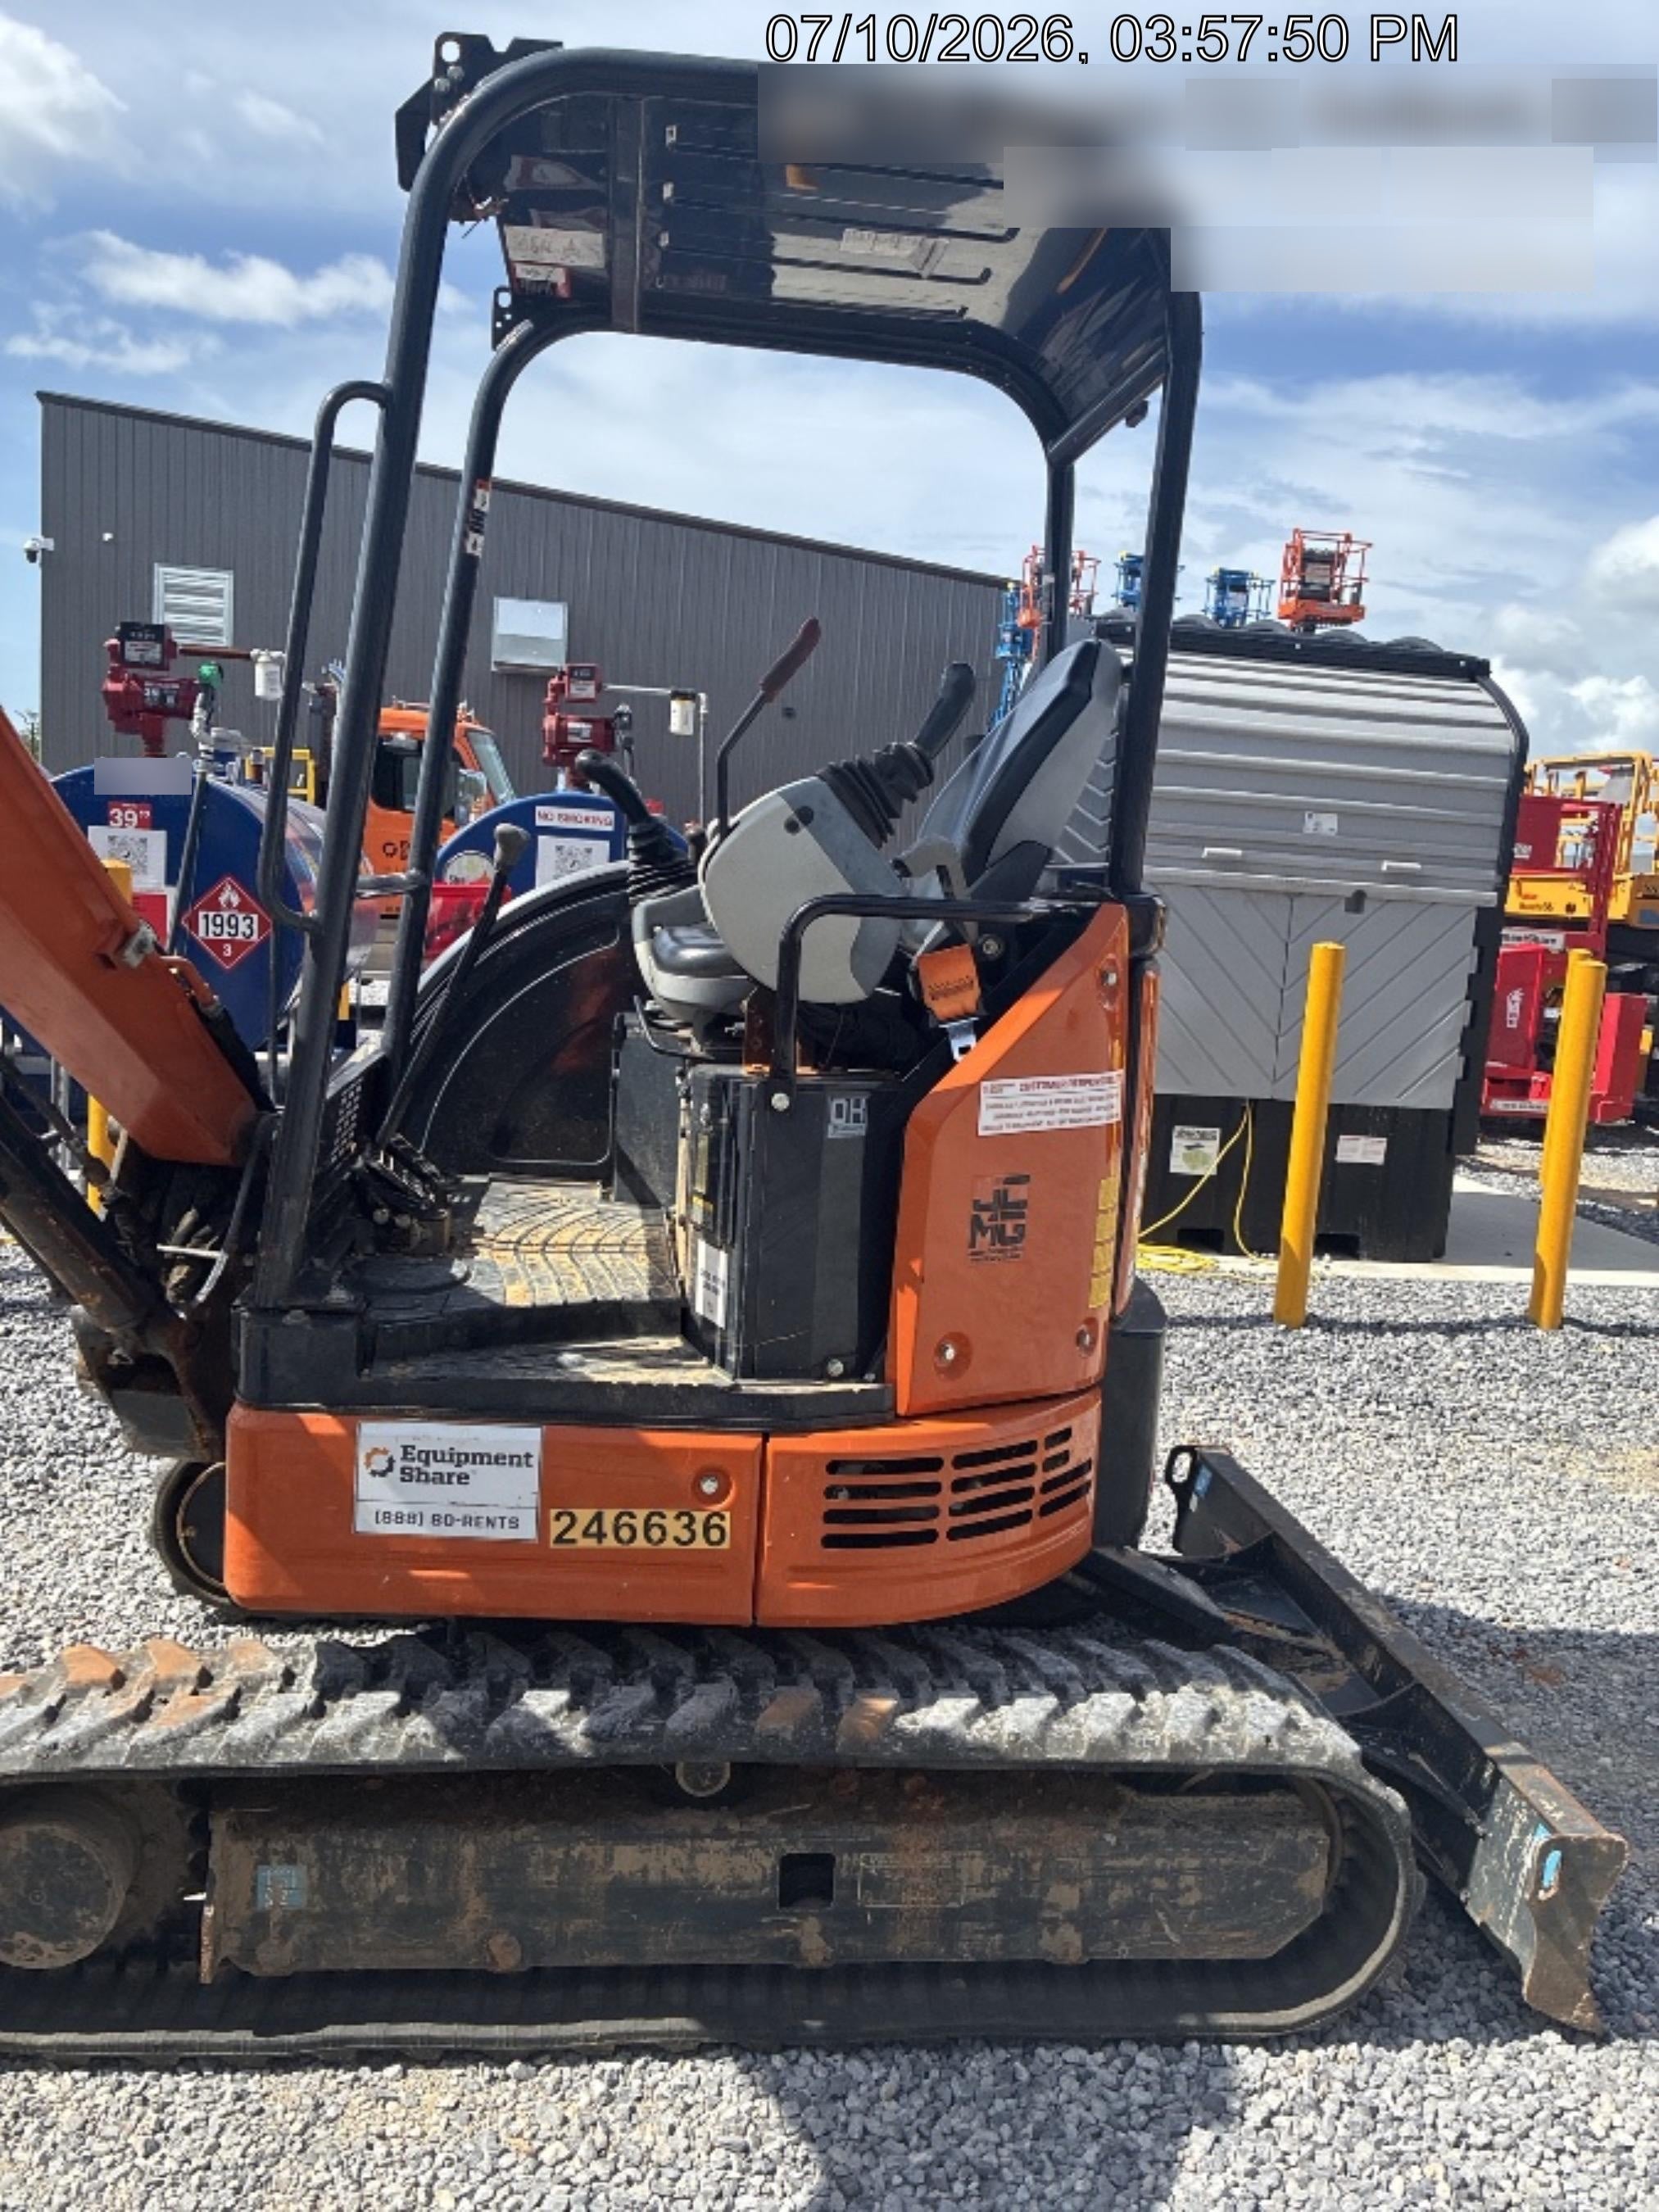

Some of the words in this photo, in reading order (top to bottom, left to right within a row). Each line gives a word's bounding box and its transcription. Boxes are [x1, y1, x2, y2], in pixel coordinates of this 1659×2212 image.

[202, 913, 255, 939] 1993
[222, 944, 233, 957] 3
[399, 1444, 534, 1468] Equipment
[399, 1466, 471, 1486] Share
[552, 1511, 726, 1547] 246636
